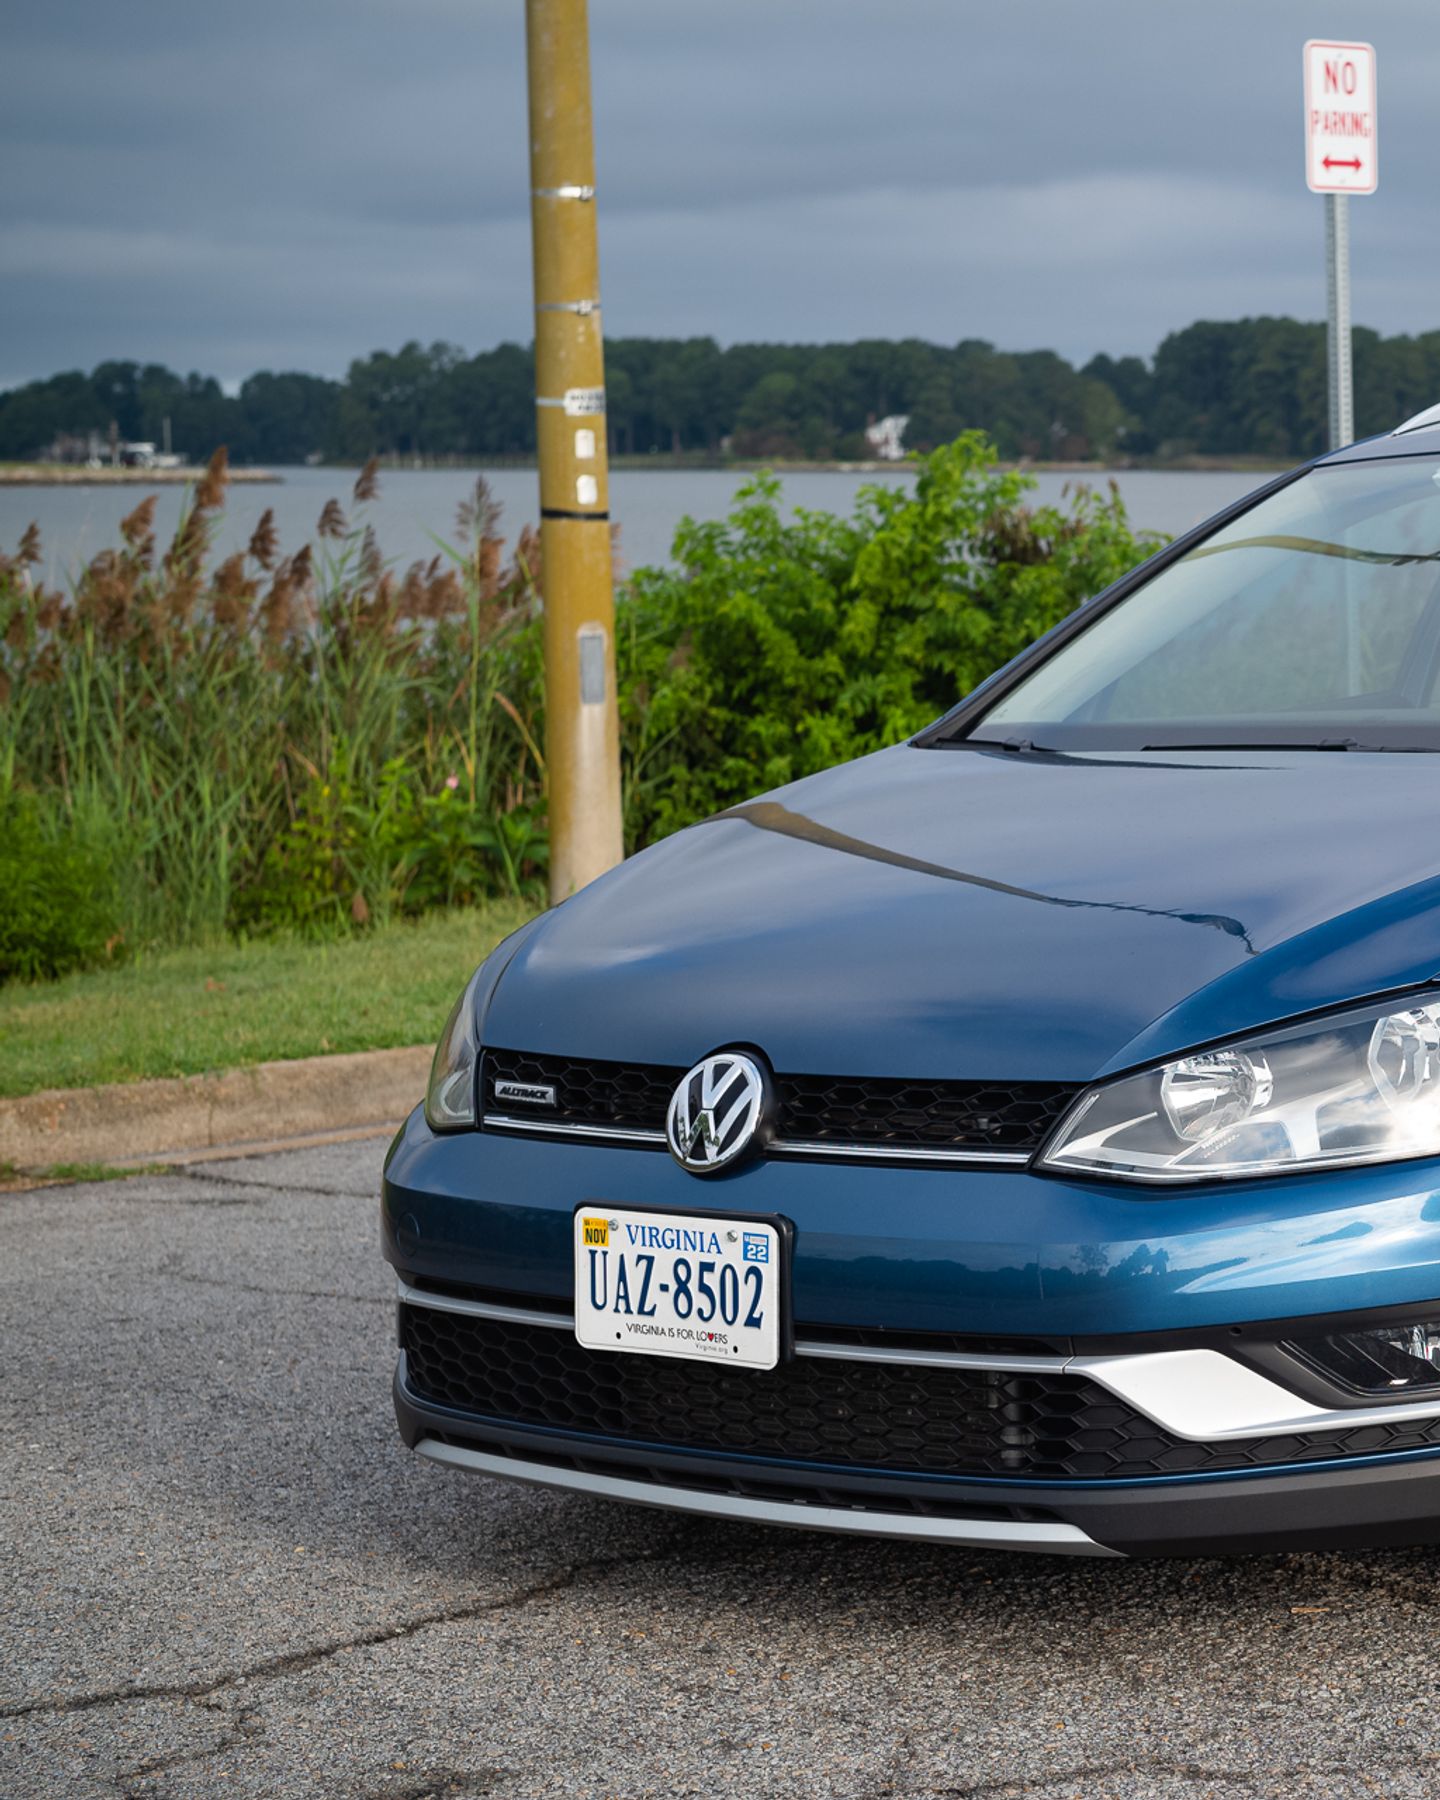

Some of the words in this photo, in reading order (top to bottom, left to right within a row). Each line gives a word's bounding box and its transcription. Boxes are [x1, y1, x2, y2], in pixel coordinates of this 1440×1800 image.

[1324, 61, 1357, 95] NO
[1311, 109, 1372, 138] PARKING
[499, 1085, 550, 1099] ALLTRACK
[585, 1228, 607, 1244] NOV
[625, 1223, 723, 1255] VIRGINIA
[747, 1245, 767, 1261] 22
[588, 1248, 764, 1330] UAZ-8502
[625, 1322, 667, 1337] VIRGINIA
[668, 1327, 675, 1338] IS
[676, 1328, 696, 1341] FOR
